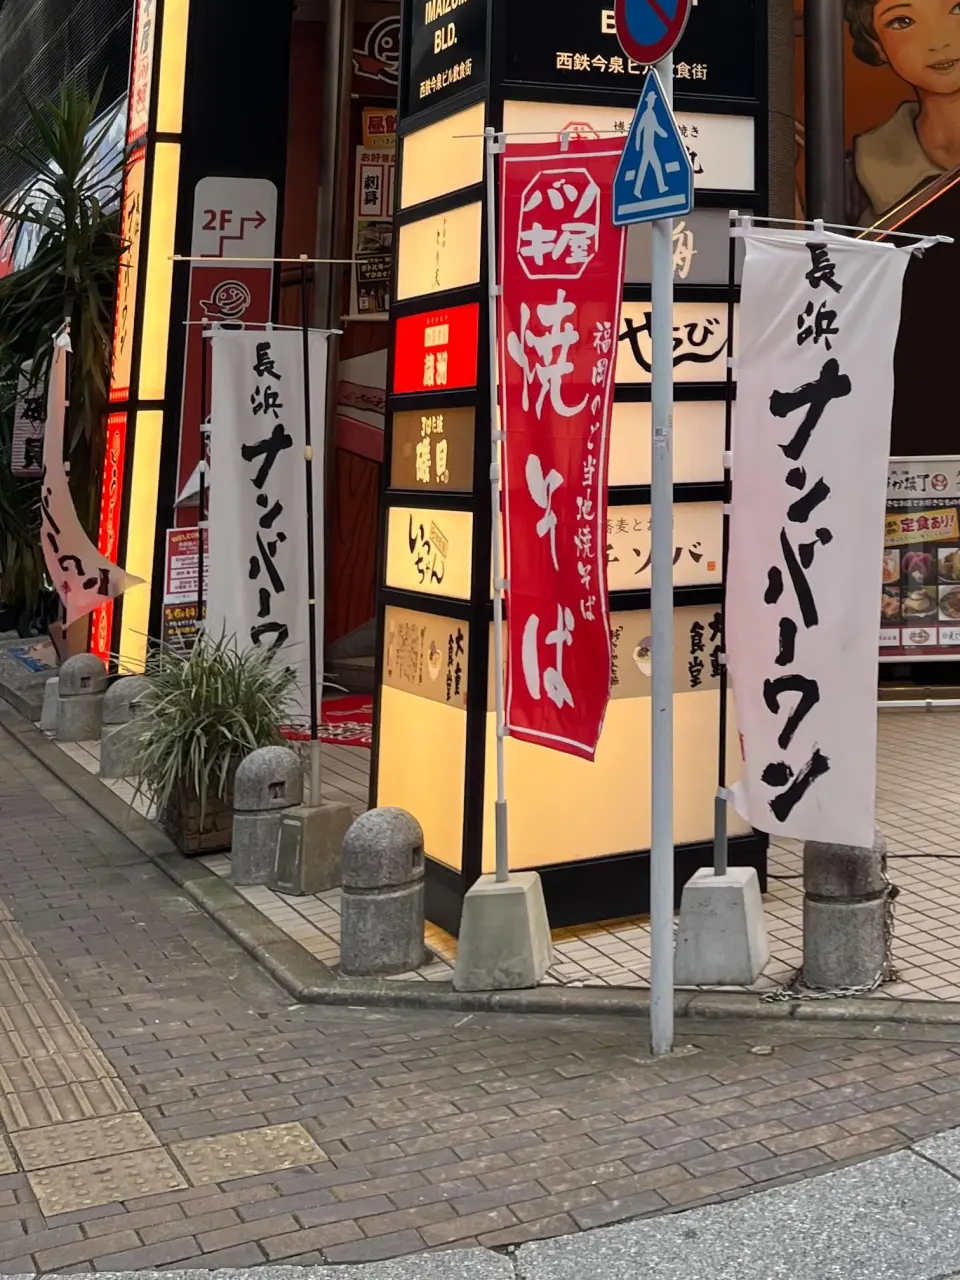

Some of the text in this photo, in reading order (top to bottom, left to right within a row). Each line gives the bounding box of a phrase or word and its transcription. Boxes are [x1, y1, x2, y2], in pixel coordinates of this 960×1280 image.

[418, 58, 473, 100] 西鉄今泉ビル飲食街
[433, 23, 457, 55] BLD.
[202, 209, 233, 231] 2F
[364, 174, 379, 206] 刺身
[796, 241, 843, 352] 長浜
[249, 341, 284, 418] 長浜
[507, 288, 590, 709] 焼そば
[574, 320, 613, 622] 福岡のご当地焼そば
[240, 424, 296, 682] ナンバーワ
[761, 357, 852, 824] ナンバーワン
